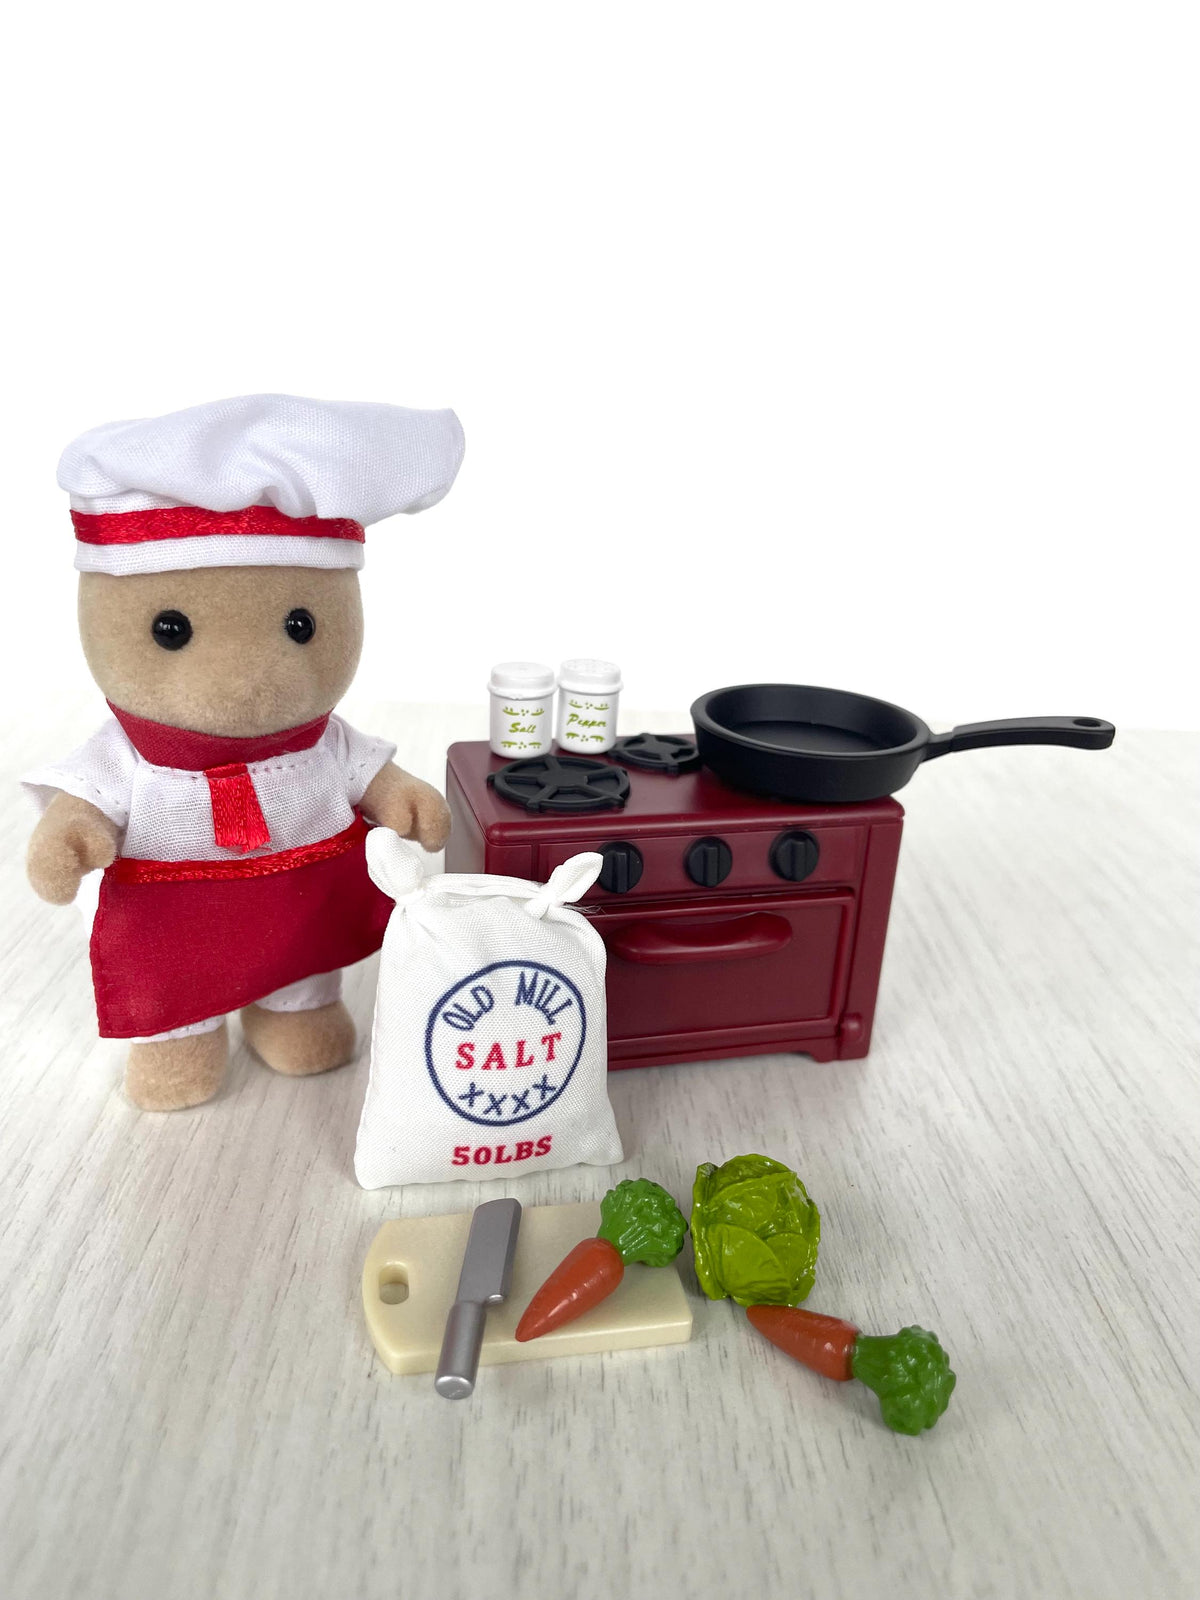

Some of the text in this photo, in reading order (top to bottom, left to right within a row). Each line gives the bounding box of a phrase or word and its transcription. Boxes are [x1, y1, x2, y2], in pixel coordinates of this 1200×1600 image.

[508, 722, 536, 734] Salt
[442, 971, 573, 1031] OLD MILL
[455, 1032, 562, 1071] SALT
[451, 1135, 553, 1166] 50LBS
